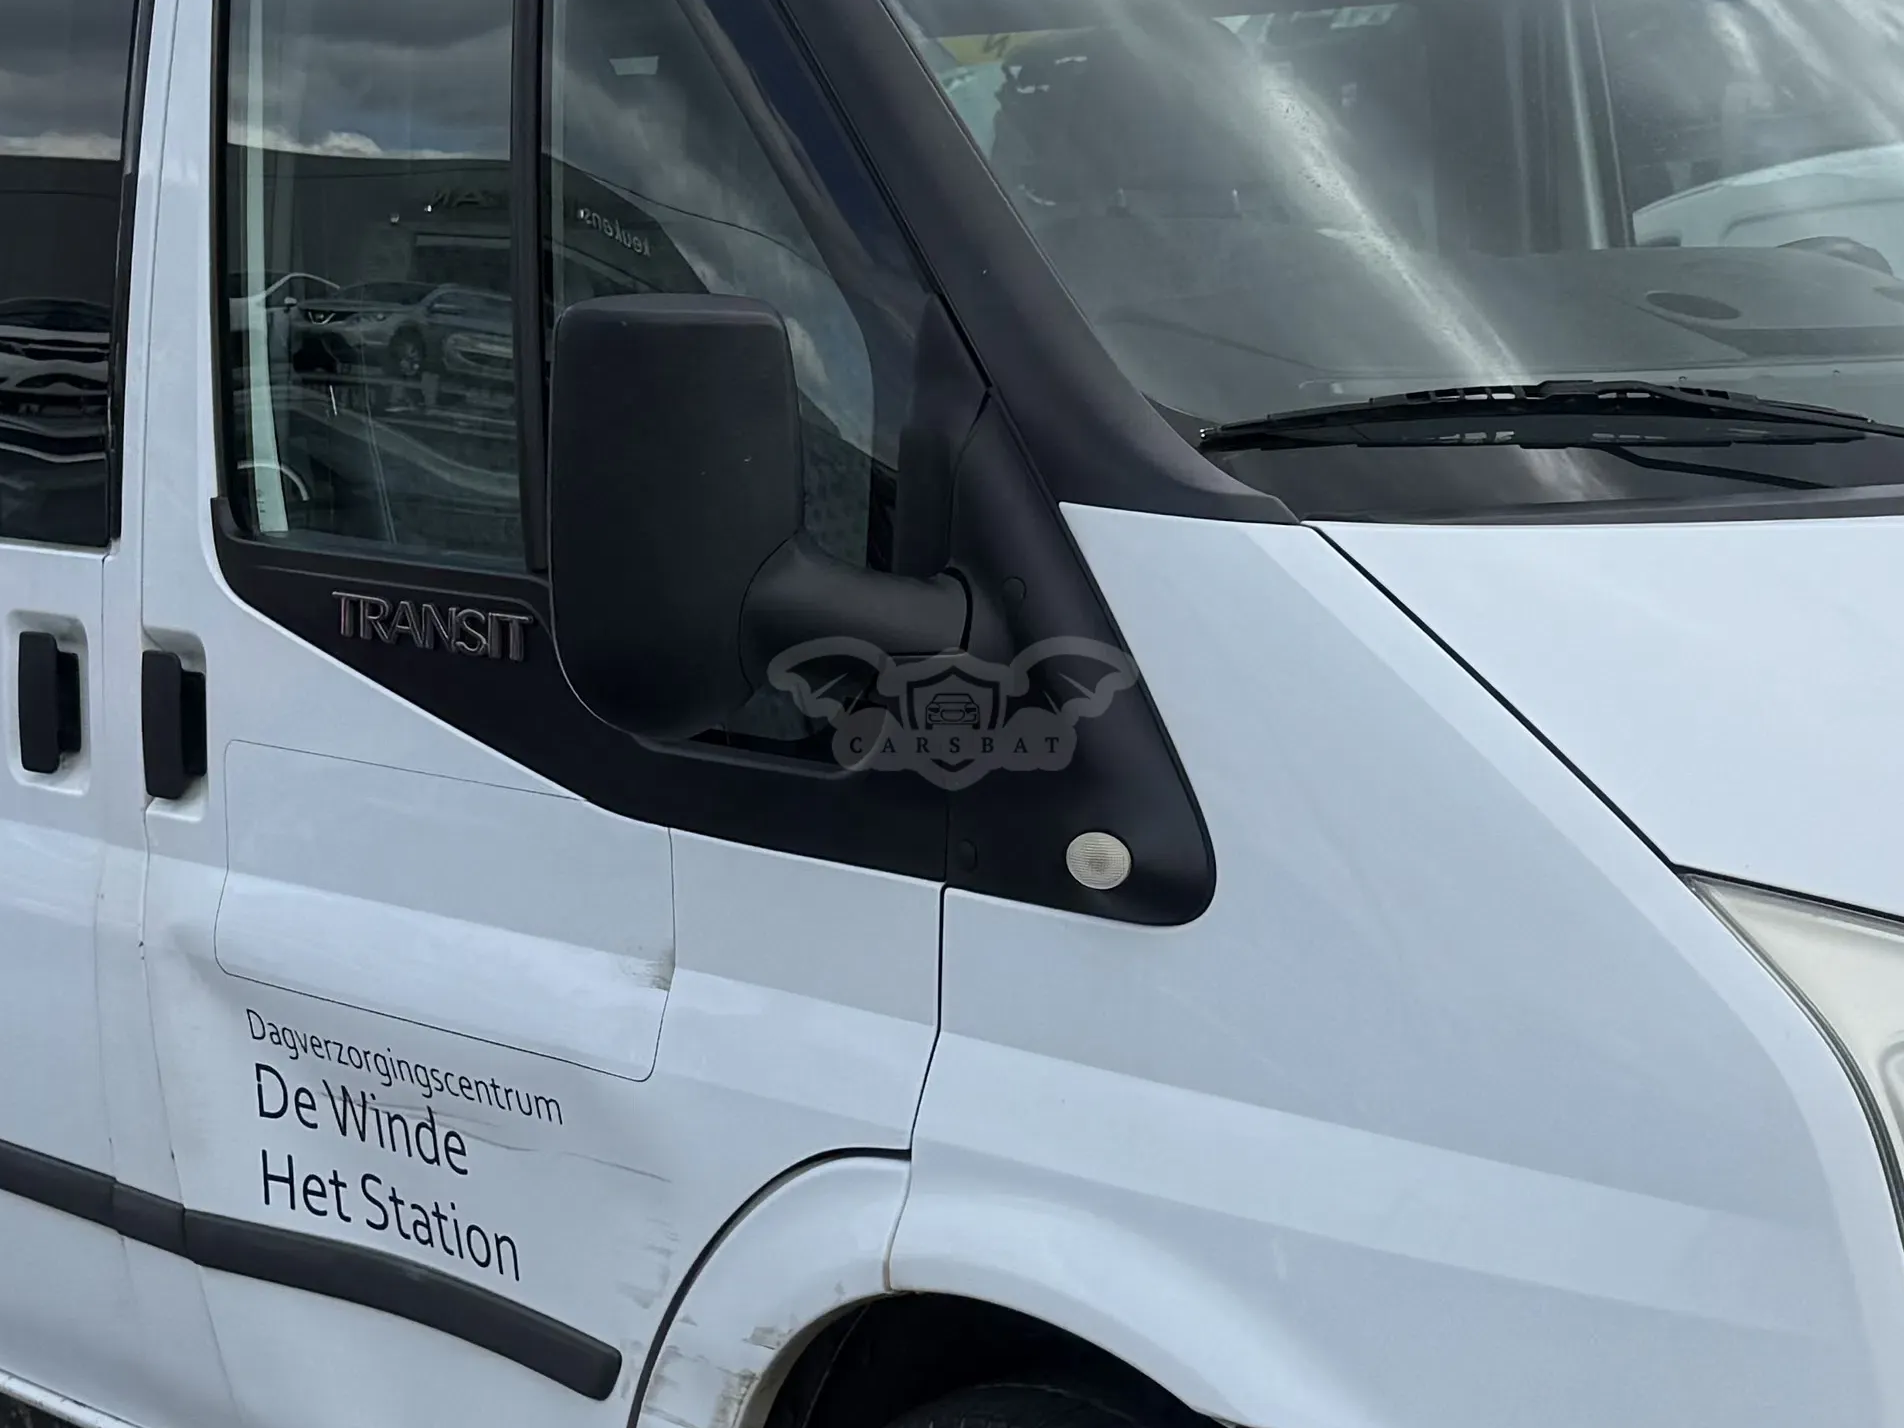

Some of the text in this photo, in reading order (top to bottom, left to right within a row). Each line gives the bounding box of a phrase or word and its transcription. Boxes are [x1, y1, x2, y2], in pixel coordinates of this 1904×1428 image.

[331, 591, 533, 661] TRANSIT
[246, 1008, 563, 1125] Dagverzorgingscentrum
[255, 1062, 468, 1175] De Winde
[261, 1149, 520, 1281] Het Station
